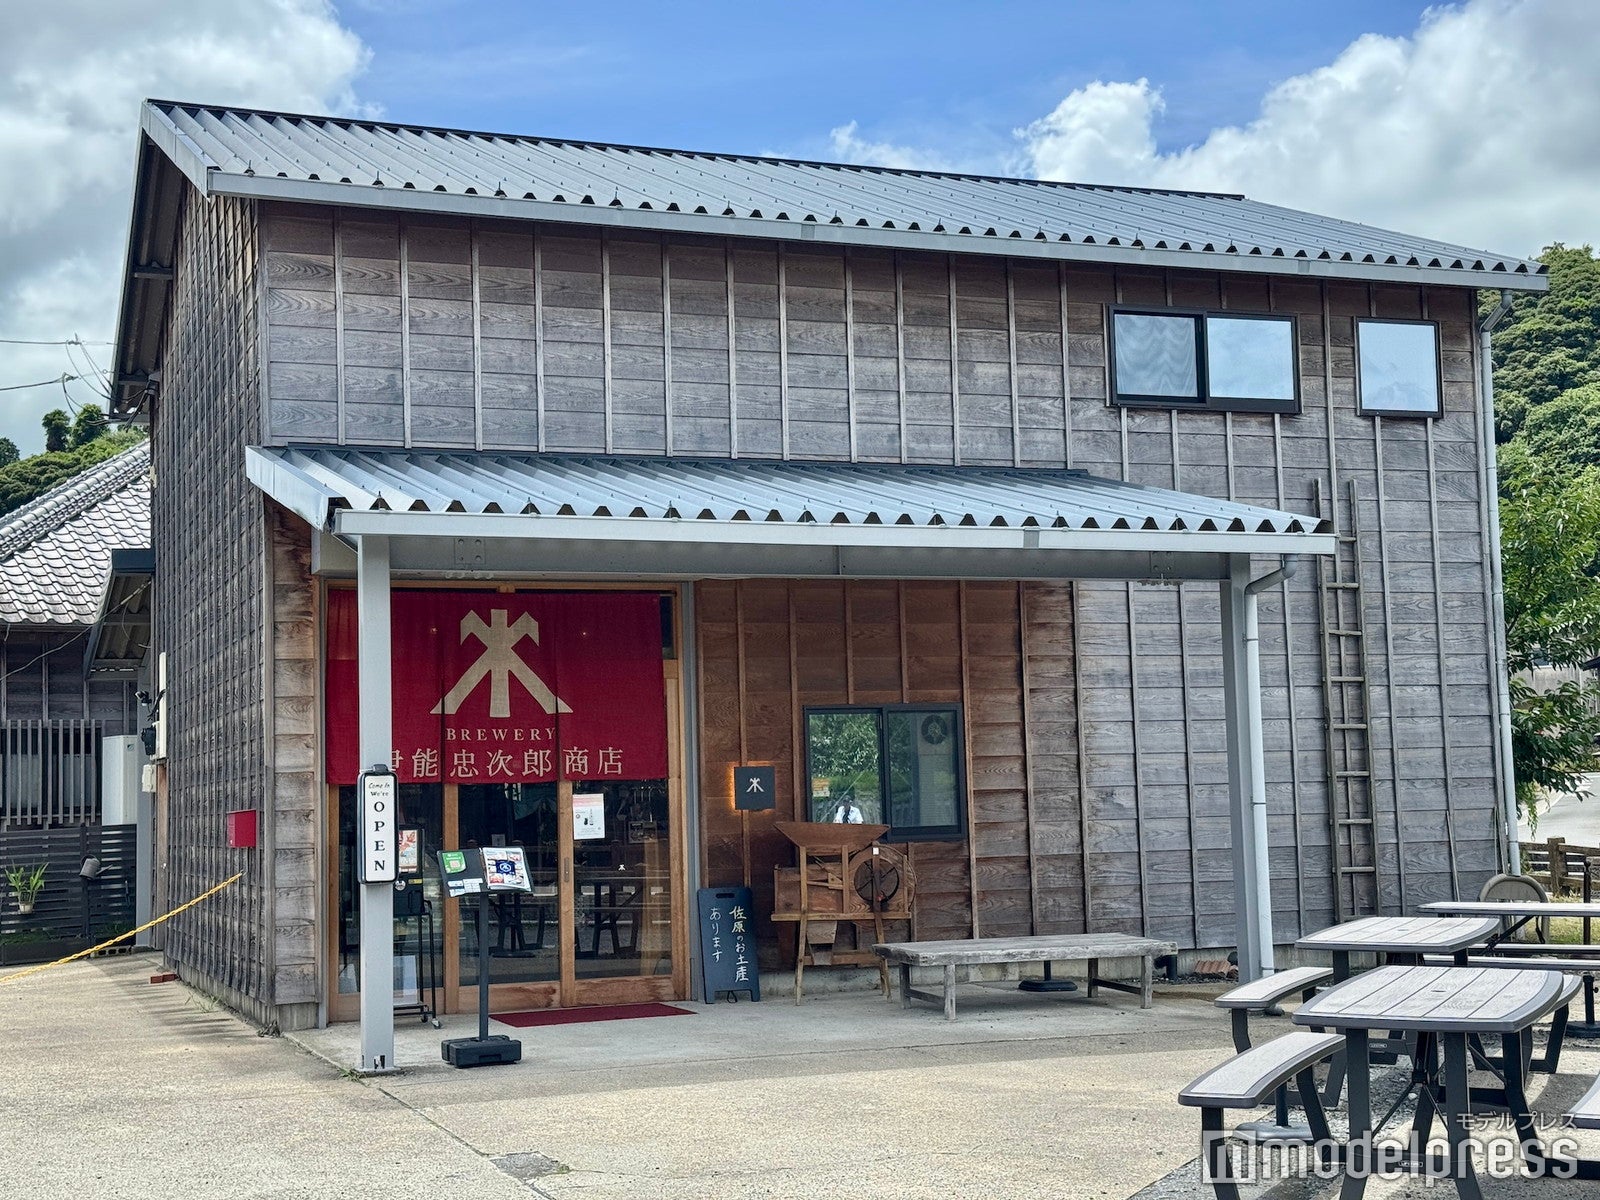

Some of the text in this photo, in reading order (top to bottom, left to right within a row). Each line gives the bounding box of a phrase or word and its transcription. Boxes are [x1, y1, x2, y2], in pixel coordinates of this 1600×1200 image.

[446, 727, 556, 741] BREWERY
[374, 801, 386, 871] OPEN
[710, 907, 722, 962] あります
[729, 906, 749, 982] 佐原のお土産
